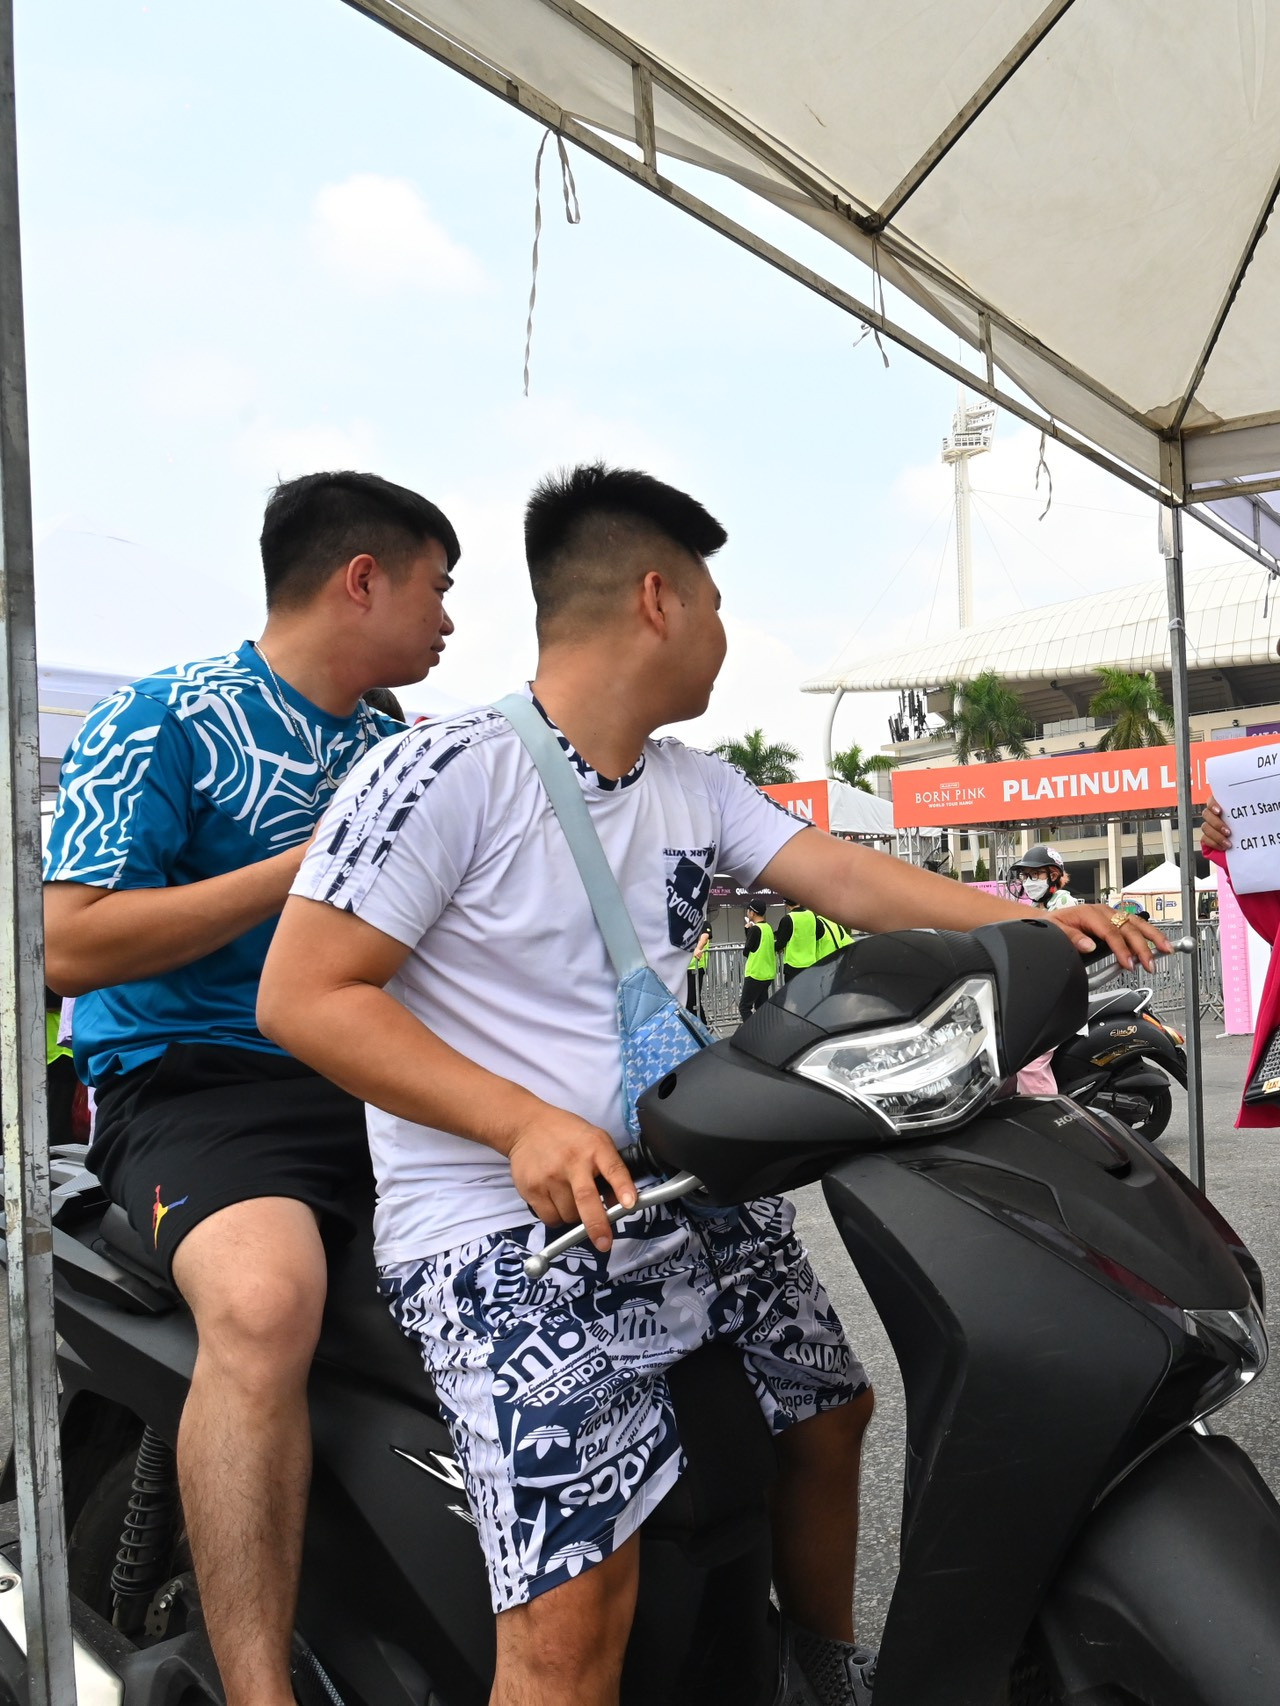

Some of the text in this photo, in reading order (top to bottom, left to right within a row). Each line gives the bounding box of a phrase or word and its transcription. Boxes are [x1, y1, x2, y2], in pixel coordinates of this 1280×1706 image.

[1257, 753, 1278, 769] DAY
[1003, 767, 1149, 802] PLATINUM
[915, 787, 986, 804] BORN PINK
[1230, 805, 1249, 820] CAT
[1251, 804, 1257, 816] 1
[1240, 835, 1258, 850] CAT
[1260, 835, 1267, 846] 1
[1269, 833, 1277, 845] R
[586, 1320, 615, 1347] LOOK
[783, 1342, 850, 1375] ADIDAS
